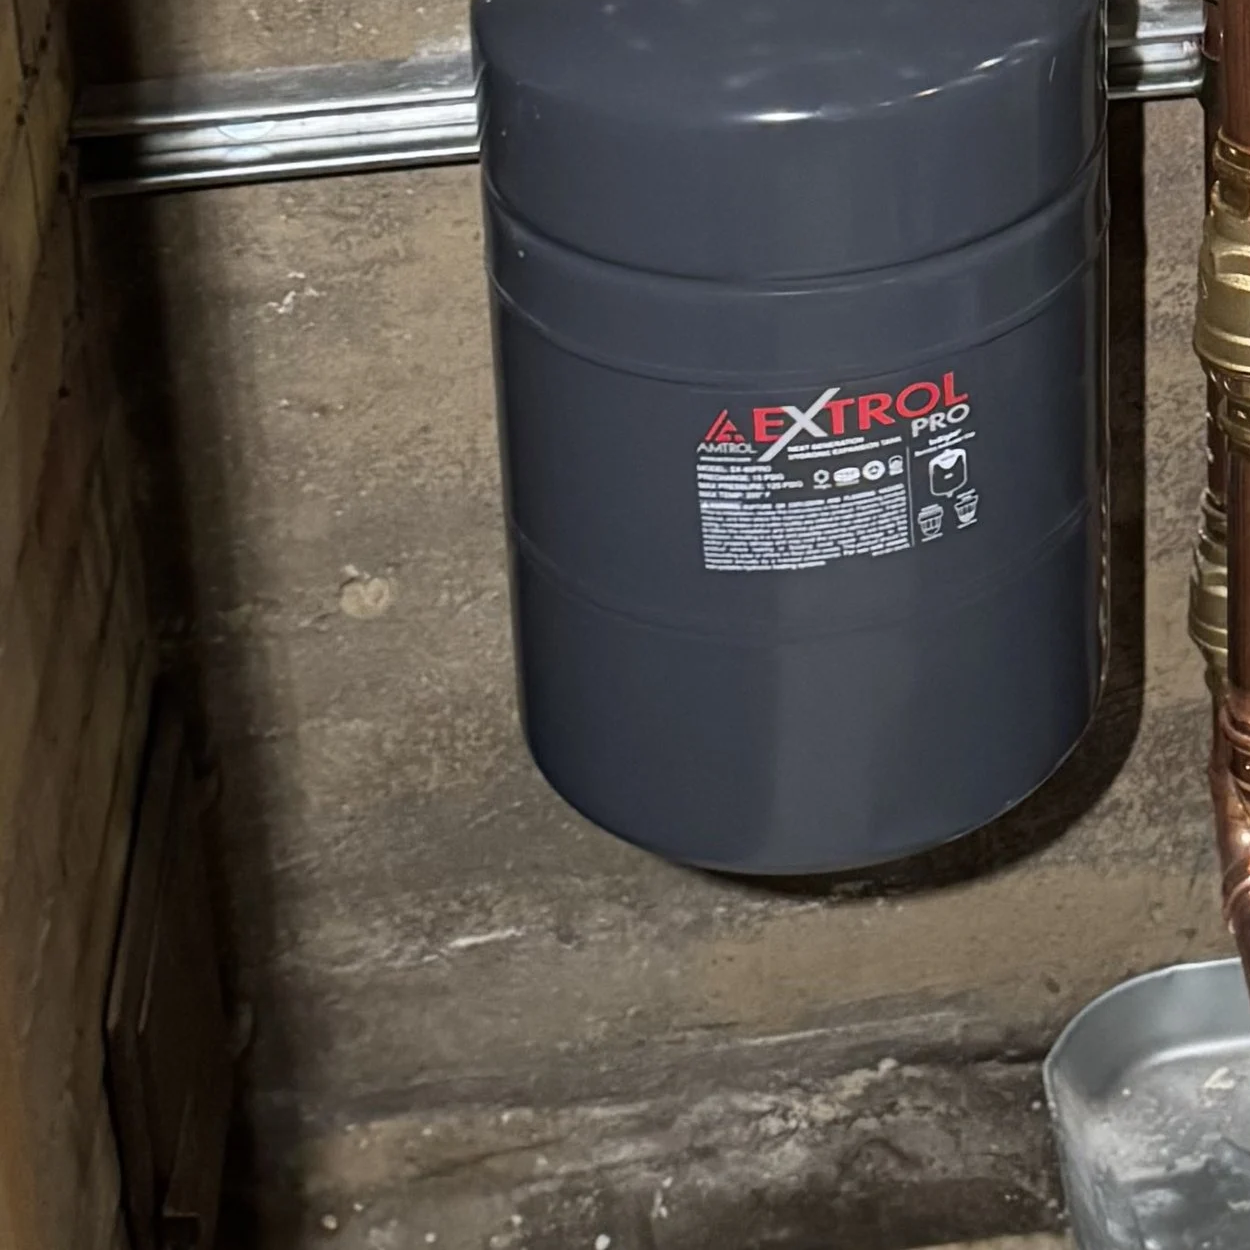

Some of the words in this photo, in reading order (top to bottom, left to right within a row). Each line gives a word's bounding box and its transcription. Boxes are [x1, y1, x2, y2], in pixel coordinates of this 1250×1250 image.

[753, 372, 968, 462] EXTROL
[911, 404, 970, 439] PRO
[696, 442, 757, 454] AMTROL
